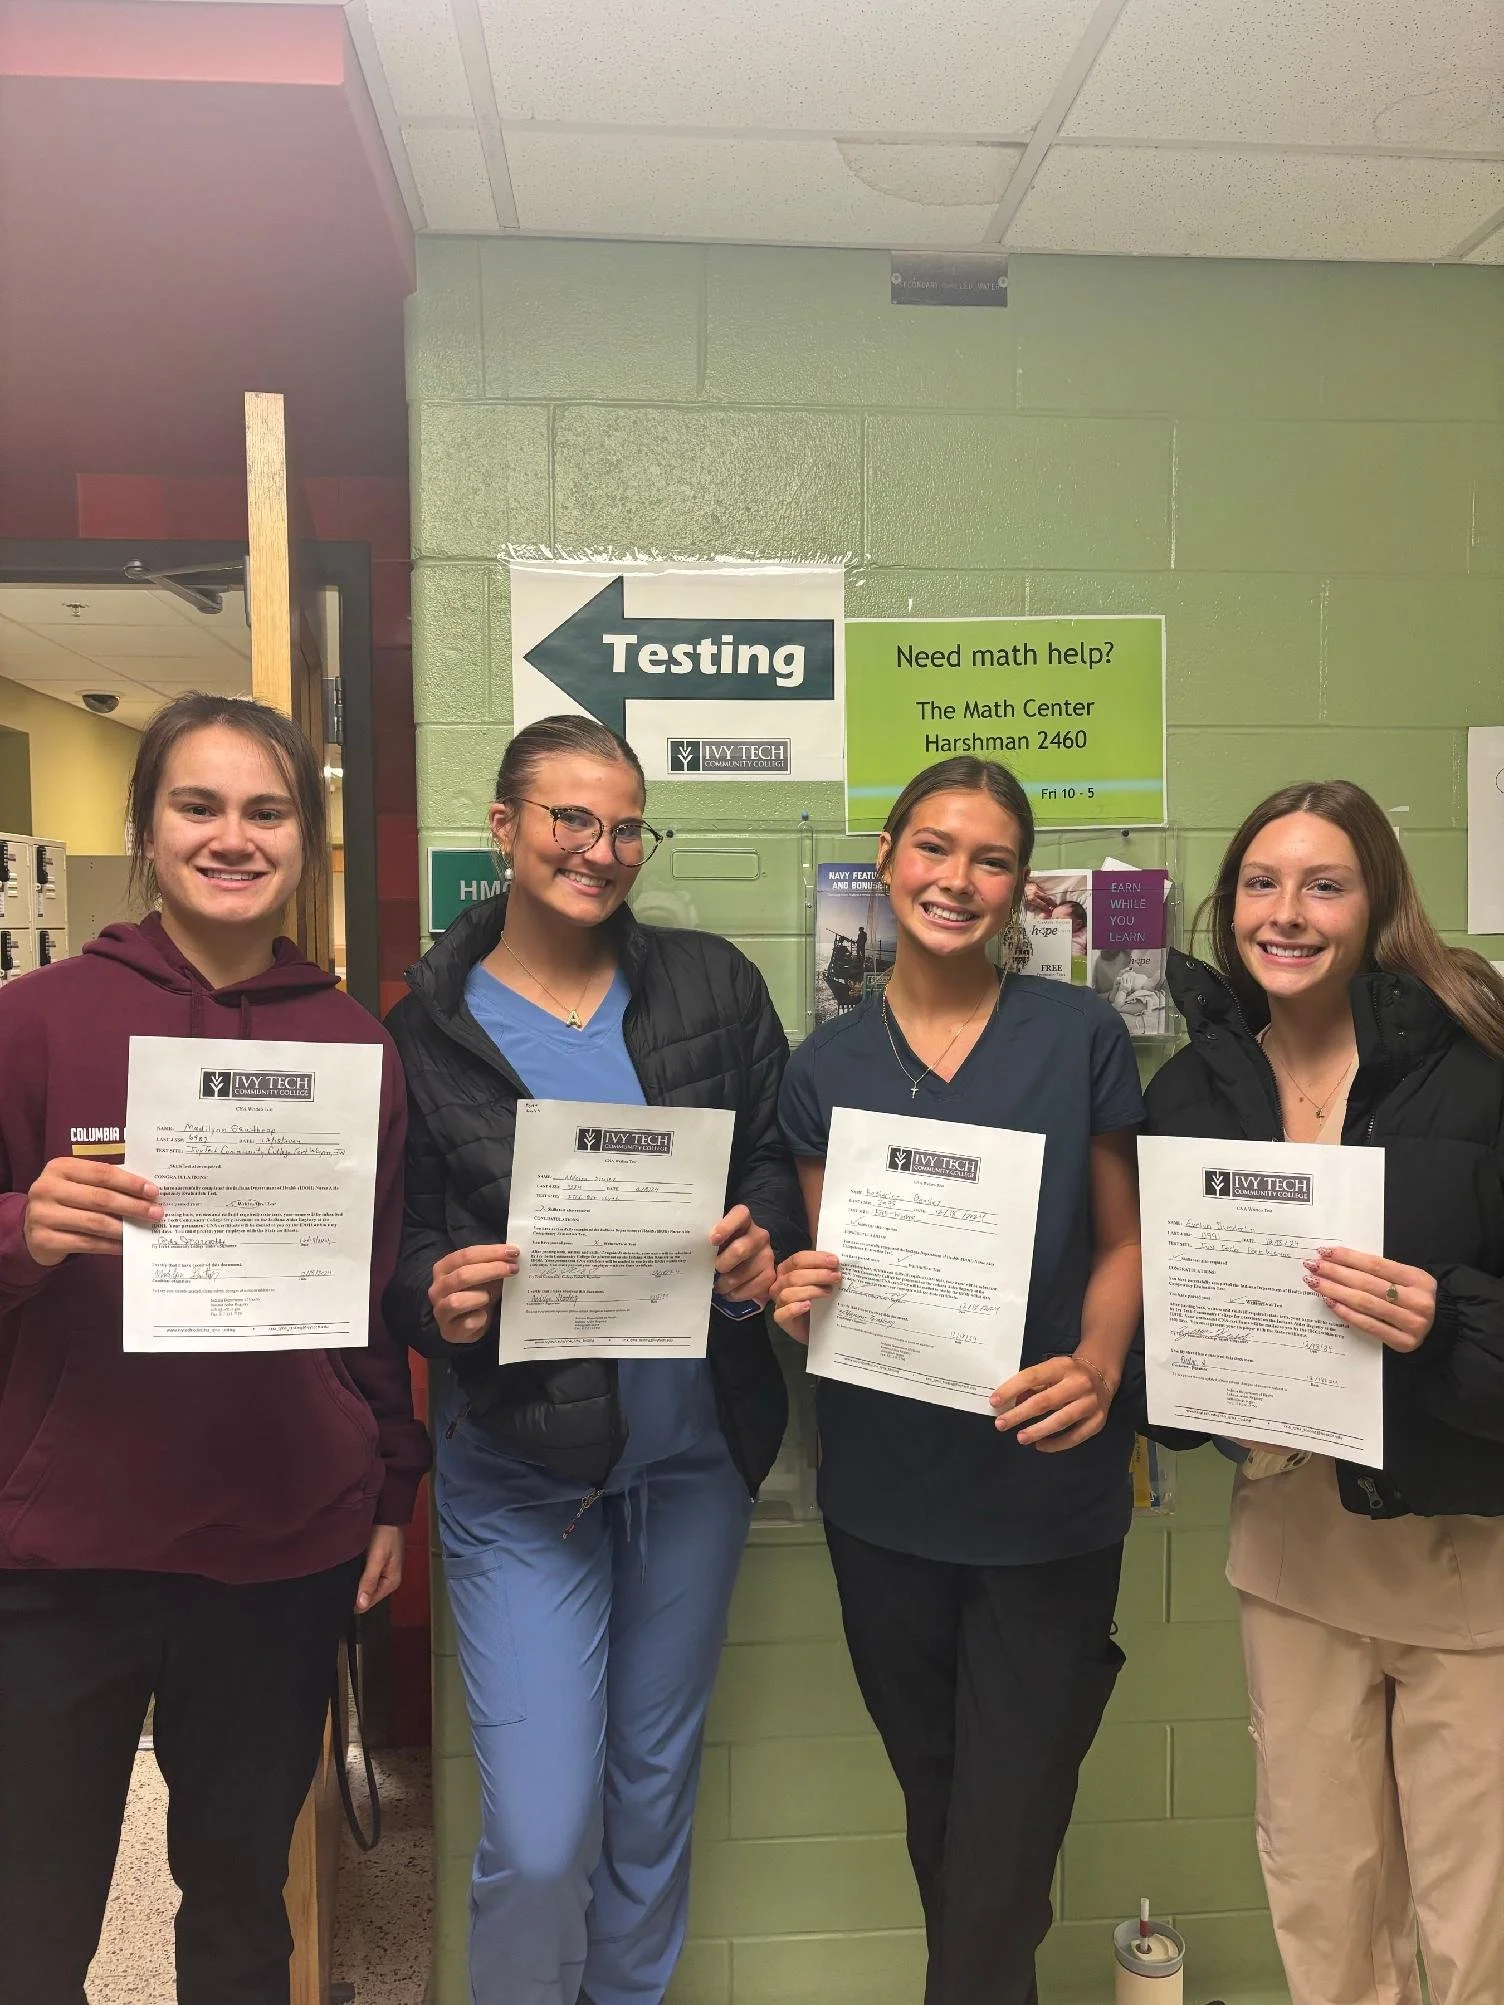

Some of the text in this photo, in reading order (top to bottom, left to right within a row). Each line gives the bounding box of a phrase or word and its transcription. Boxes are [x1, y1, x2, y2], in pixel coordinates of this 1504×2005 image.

[602, 633, 806, 688] Testing
[897, 641, 1114, 670] Need math help?
[915, 698, 1095, 720] The Math Center
[925, 729, 1087, 753] Harshman 2460
[704, 745, 784, 760] IVY TECH
[704, 760, 785, 768] COMMUNITY COLLEGE
[1041, 787, 1057, 800] Fri
[1062, 787, 1076, 799] 10
[1087, 787, 1095, 799] 5
[828, 871, 878, 880] NAVY FEATU
[832, 881, 849, 890] AND
[1111, 882, 1141, 893] EARN
[1110, 899, 1148, 909] WHILE
[1110, 915, 1135, 926] YOU
[1109, 931, 1145, 942] LEARN
[1041, 964, 1063, 972] FREE
[235, 1075, 309, 1090] IVY TECH
[70, 1126, 120, 1142] COLUMBIA
[605, 1132, 669, 1146] IVY TECH
[914, 1154, 976, 1173] IVY TECH
[1235, 1175, 1308, 1193] IVY TECH
